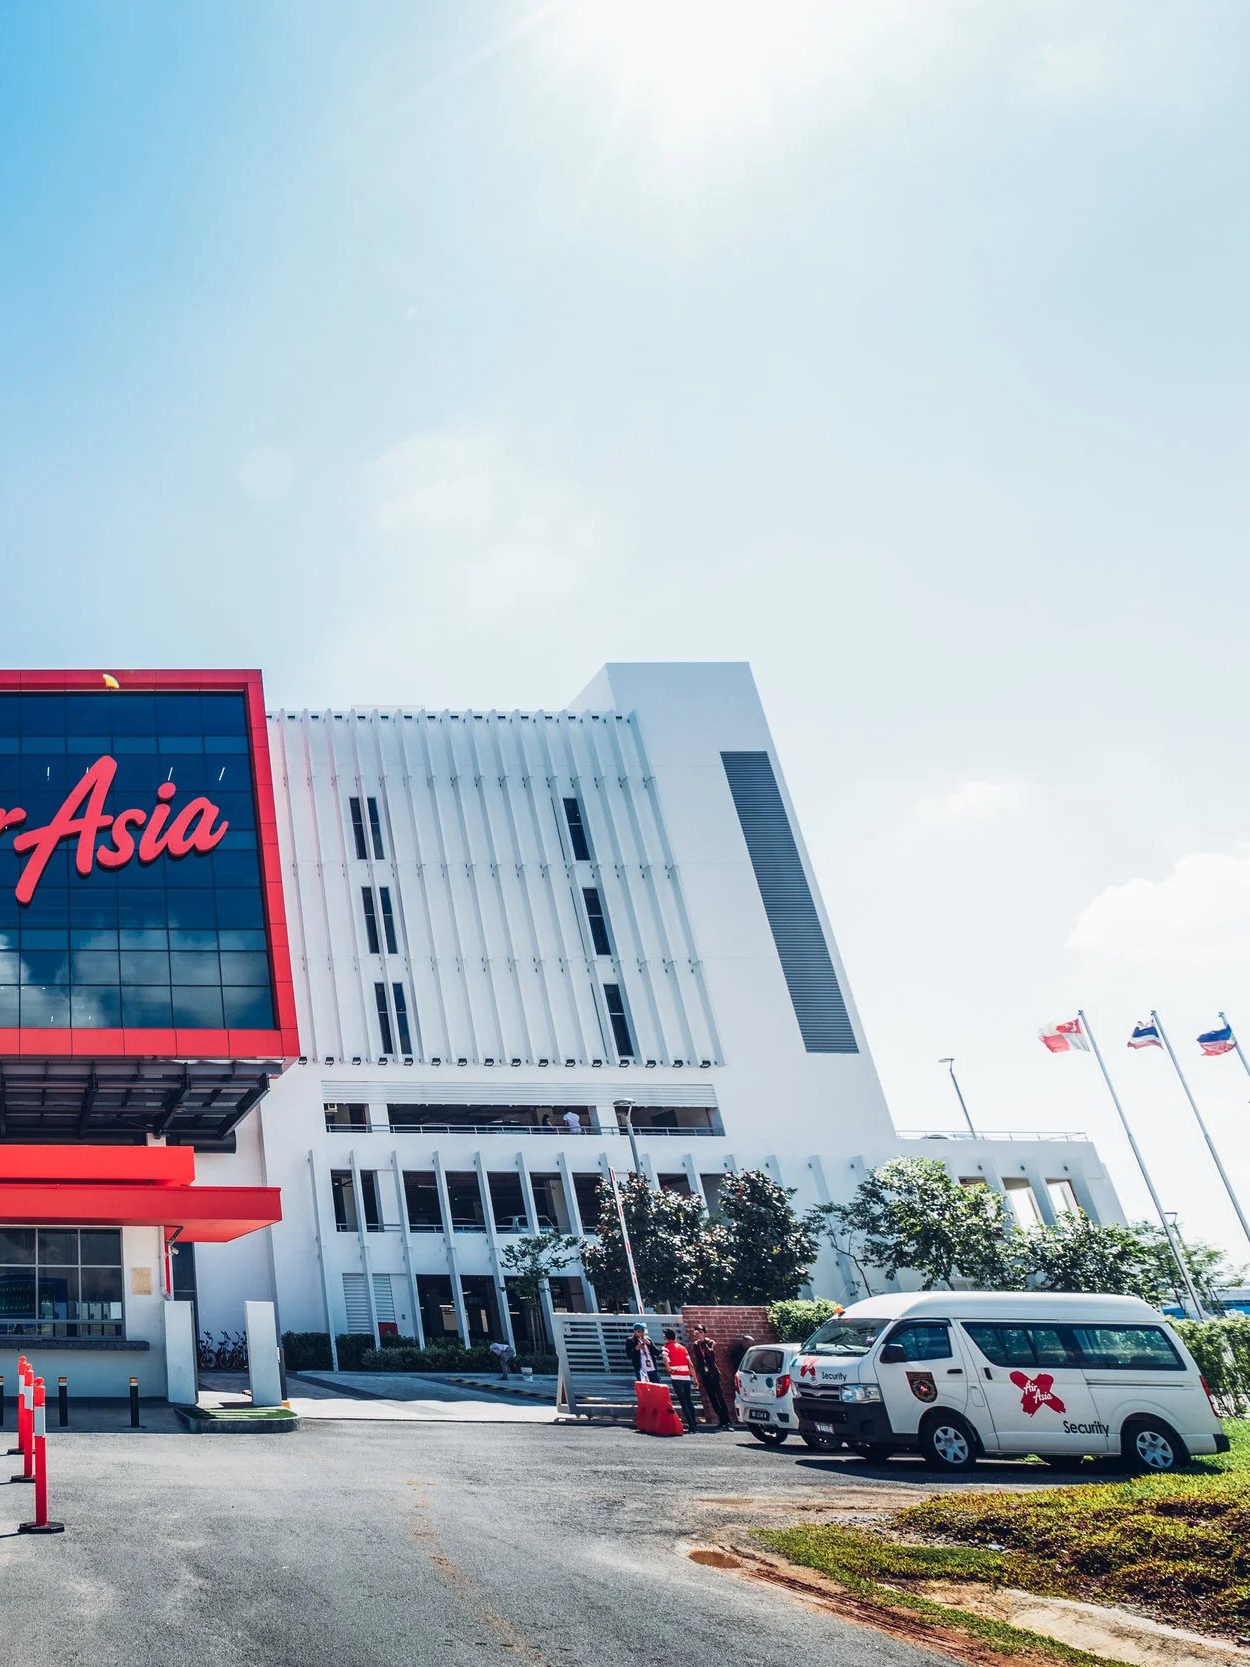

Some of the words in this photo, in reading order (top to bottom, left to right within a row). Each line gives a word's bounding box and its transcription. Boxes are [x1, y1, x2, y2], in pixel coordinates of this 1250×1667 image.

[821, 1371, 847, 1382] Security
[1023, 1380, 1038, 1396] Air
[1033, 1388, 1053, 1404] Asia
[1063, 1420, 1109, 1438] Security
